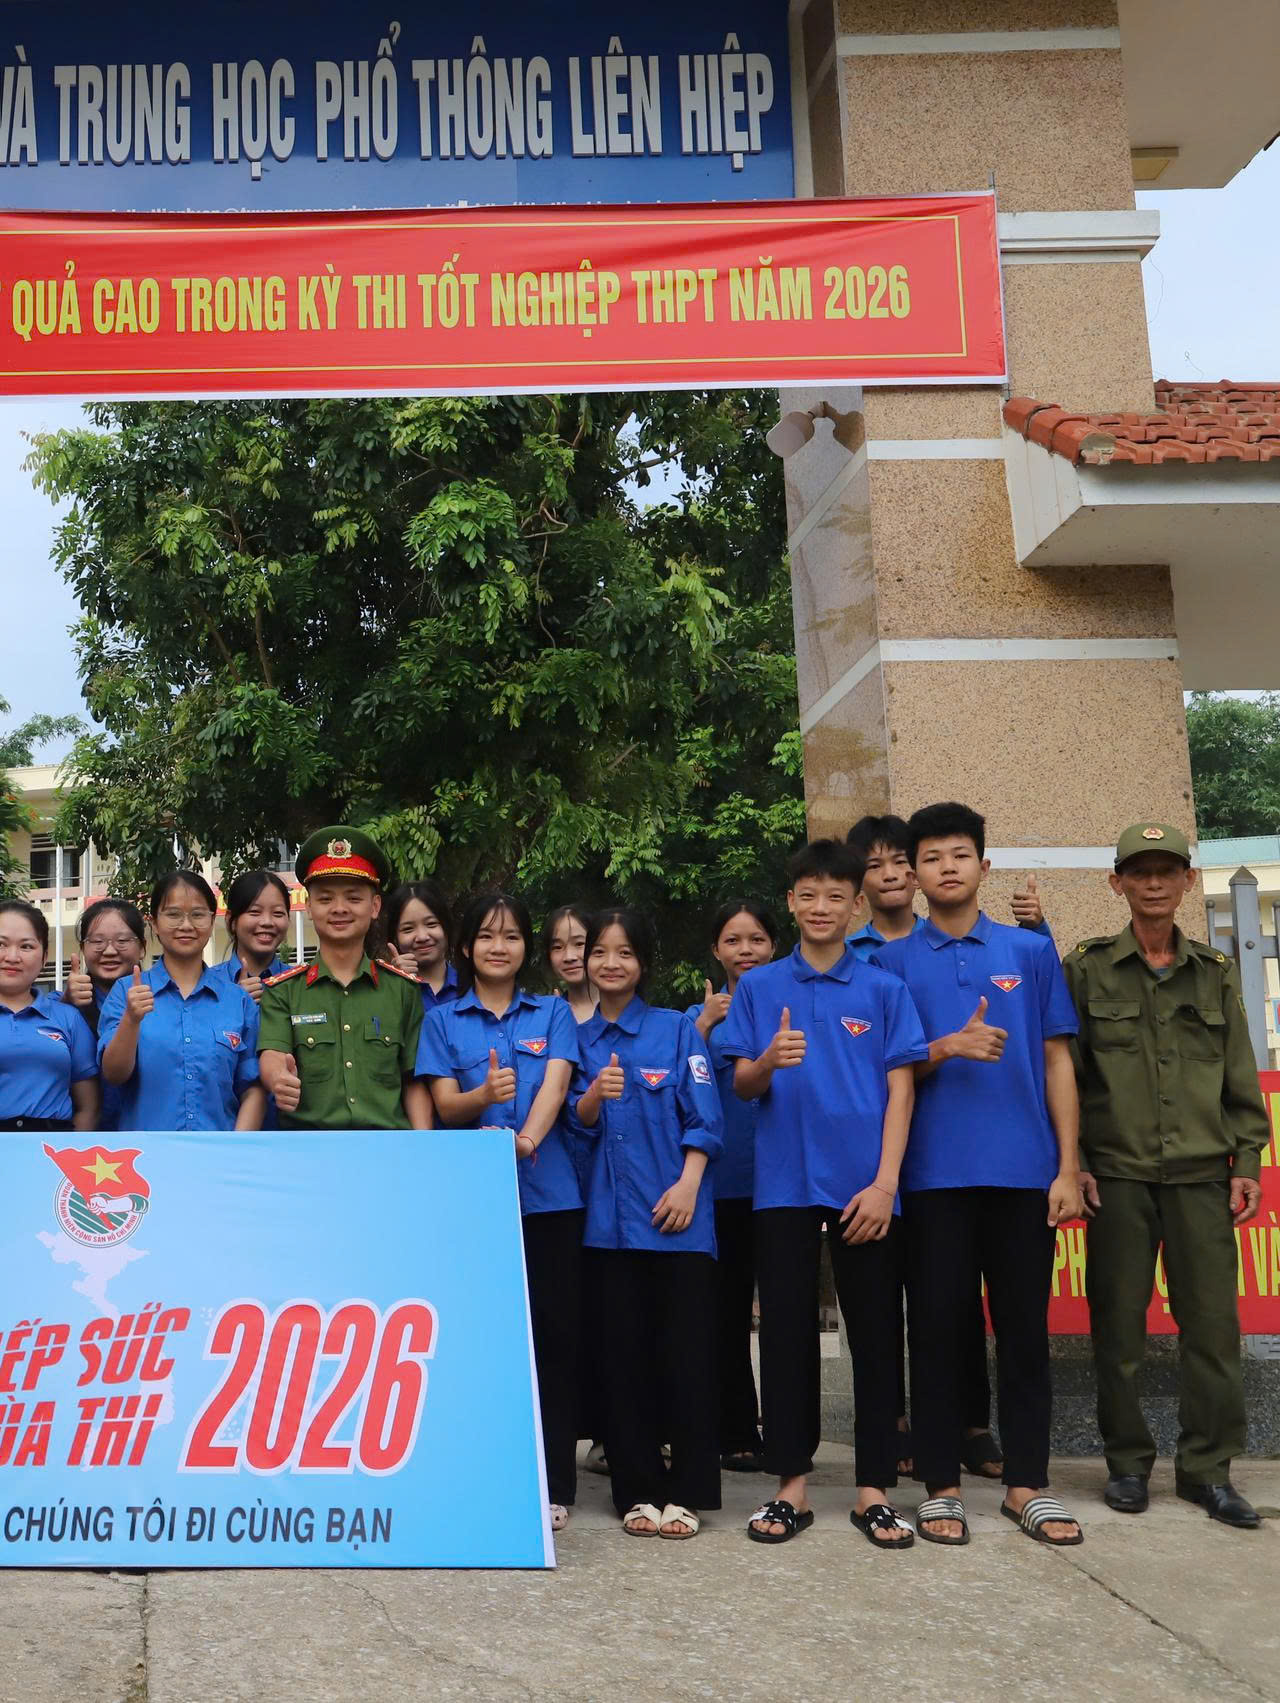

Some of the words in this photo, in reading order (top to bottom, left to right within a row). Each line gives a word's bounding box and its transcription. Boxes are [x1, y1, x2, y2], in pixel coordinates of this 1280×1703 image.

[55, 62, 190, 165] TRUNG
[213, 59, 294, 181] HỌC
[316, 21, 401, 161] PHỔ
[412, 35, 553, 159] THÔNG
[569, 35, 662, 156] LIÊN
[679, 33, 774, 171] HIỆP
[13, 261, 80, 340] QUẢ
[94, 279, 159, 333] CAO
[172, 277, 285, 331] TRONG
[299, 264, 341, 329] KỲ
[353, 275, 406, 328] THI
[419, 256, 479, 327] TỐT
[492, 260, 620, 336] NGHIỆP
[632, 269, 716, 323] THPT
[730, 256, 812, 320] NĂM
[824, 267, 910, 318] 2026
[77, 1303, 190, 1385] SỨC
[184, 1304, 434, 1470] 2026
[67, 1393, 164, 1467] THI
[5, 1498, 113, 1542] CHÚNG
[127, 1500, 176, 1542] TÔI
[187, 1508, 215, 1541] ĐI
[227, 1500, 313, 1543] CÙNG
[327, 1508, 391, 1549] BẠN
